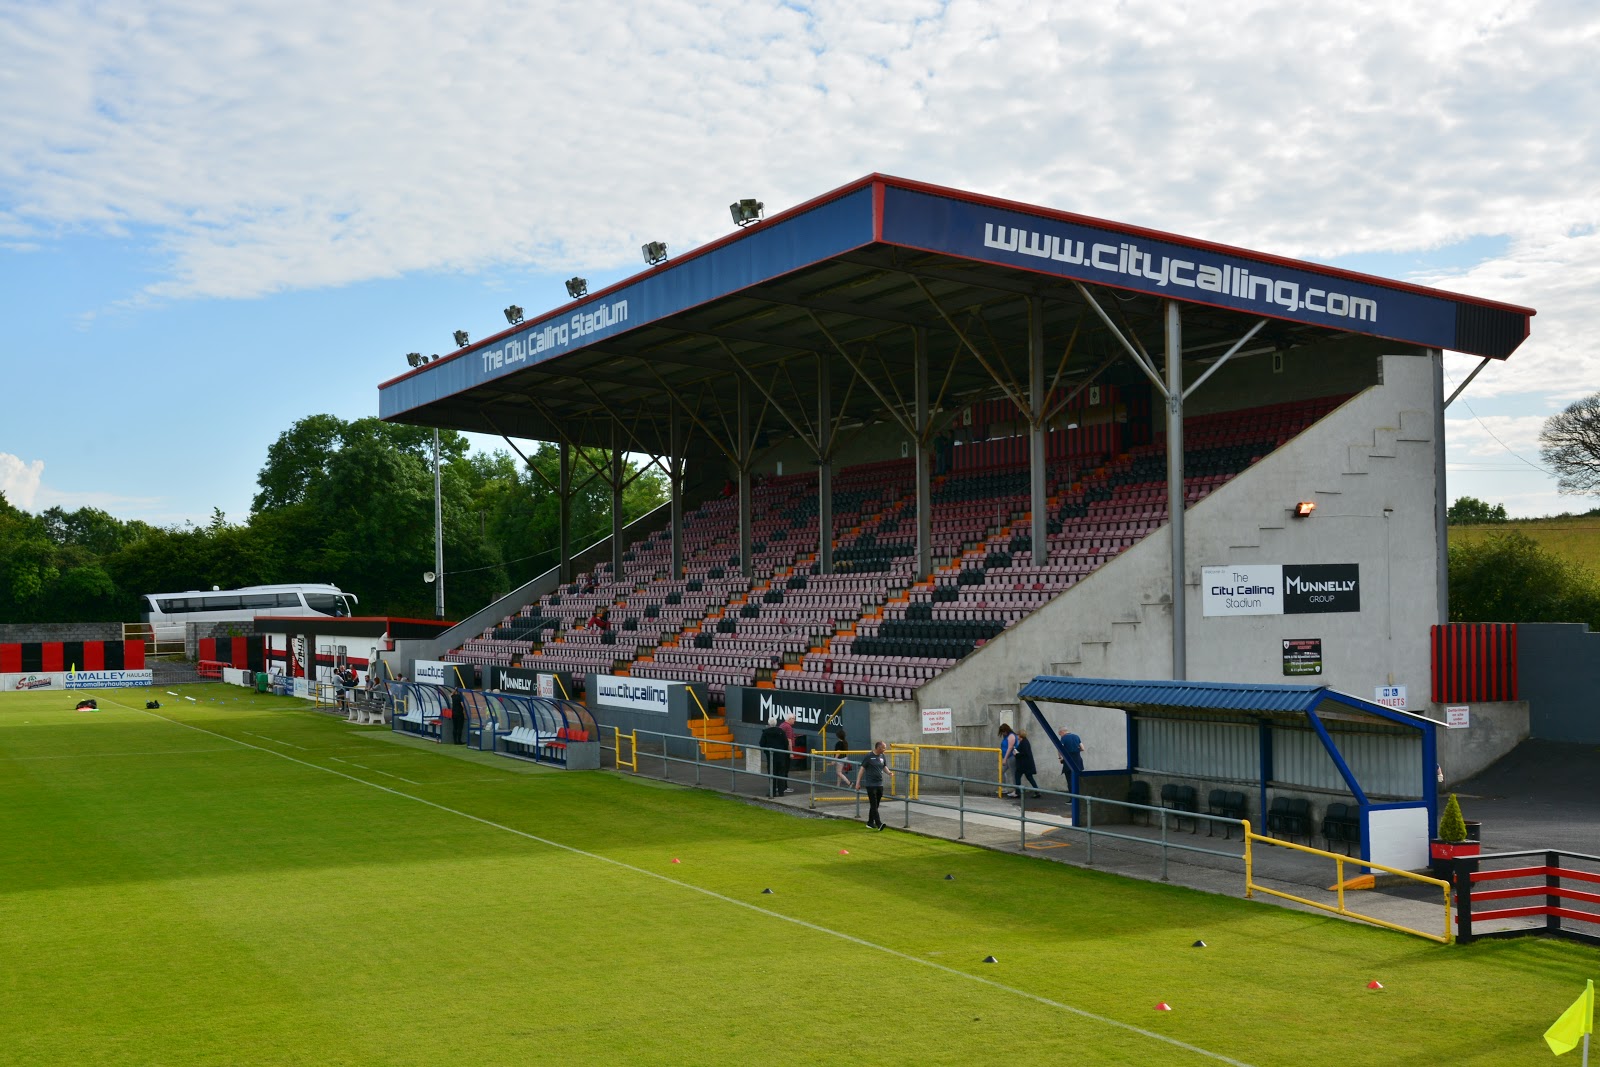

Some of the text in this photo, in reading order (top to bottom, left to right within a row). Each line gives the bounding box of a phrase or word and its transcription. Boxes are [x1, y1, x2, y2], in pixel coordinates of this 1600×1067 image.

[984, 222, 1377, 322] www.citycalling.com
[482, 299, 628, 373] The City Calling Stadium
[1232, 572, 1249, 583] The
[1286, 575, 1356, 595] MUNNELLY
[1211, 585, 1275, 597] City Calling
[1225, 598, 1262, 609] Stadium
[1309, 595, 1335, 603] GROUP
[66, 680, 152, 688] www.omalleyhaulage.co.uk
[500, 670, 532, 691] MUNNELLY
[1377, 698, 1405, 707] TOILETS
